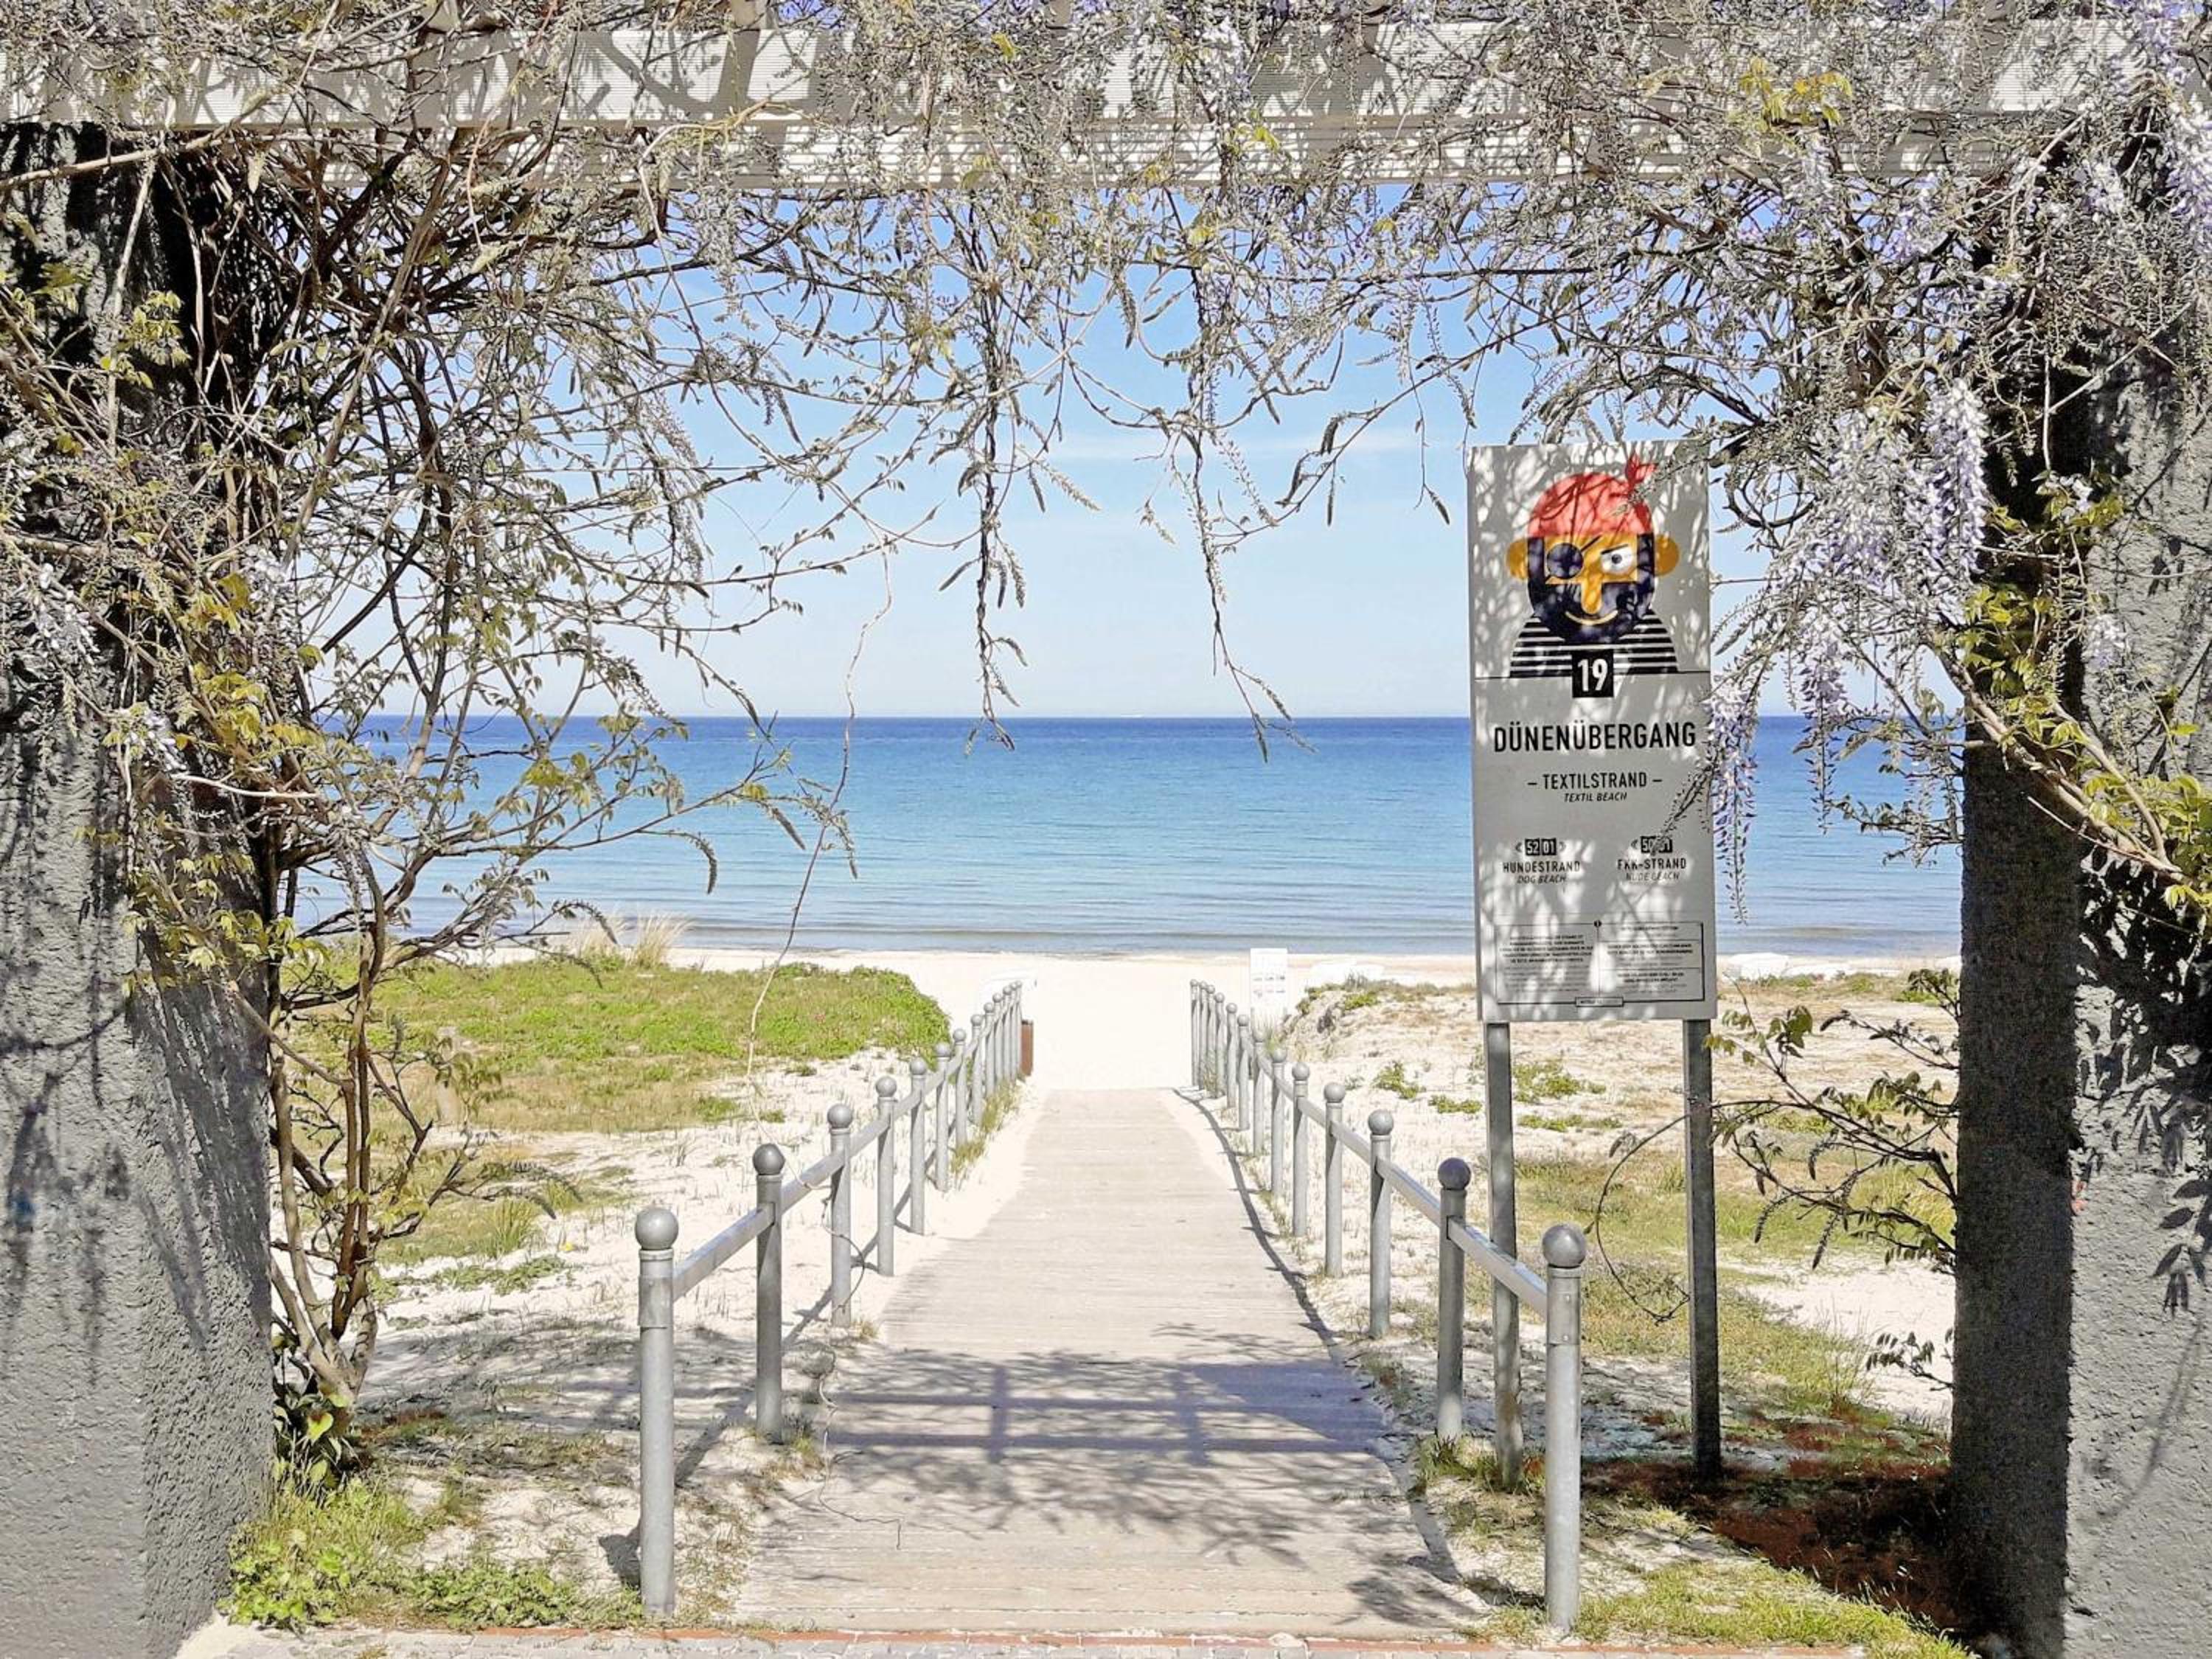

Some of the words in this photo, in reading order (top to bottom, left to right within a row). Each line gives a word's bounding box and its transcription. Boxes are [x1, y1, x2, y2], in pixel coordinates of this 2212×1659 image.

[1577, 658, 1608, 691] 19
[1494, 720, 1696, 752] DÜNENÜBERGANG
[1543, 772, 1647, 790] TEXTILSTRAND
[1563, 793, 1593, 802] TEXTIL
[1596, 792, 1627, 801] BEACH
[1543, 841, 1554, 854] 01
[1503, 860, 1580, 874] HUNDESTRAND
[1617, 858, 1686, 870] FKK-STRAND
[1517, 875, 1536, 884] DOG
[1538, 874, 1567, 884] BEACH
